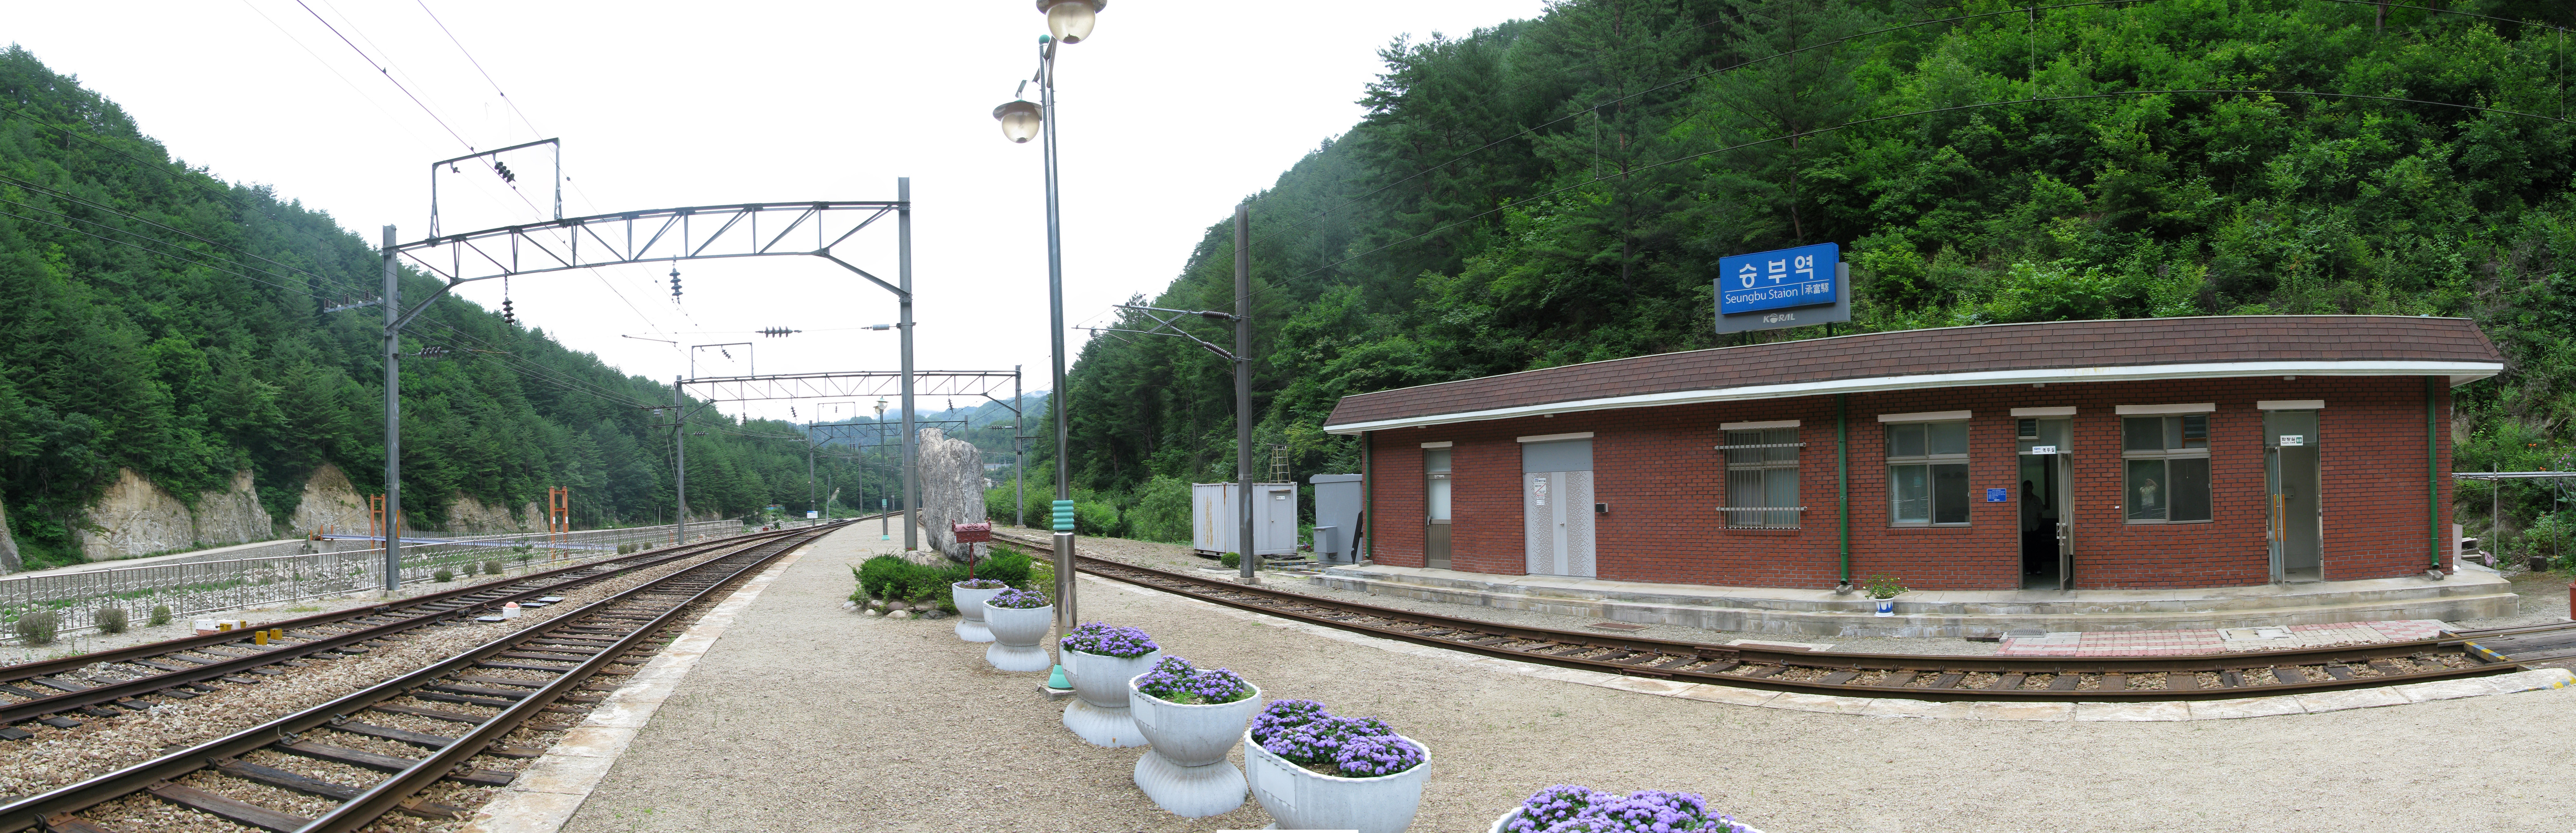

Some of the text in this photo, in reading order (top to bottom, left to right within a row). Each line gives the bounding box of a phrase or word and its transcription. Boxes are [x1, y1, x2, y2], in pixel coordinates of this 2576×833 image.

[1726, 288, 1798, 304] Seungbu Staion
[1763, 313, 1795, 324] KORAIL
